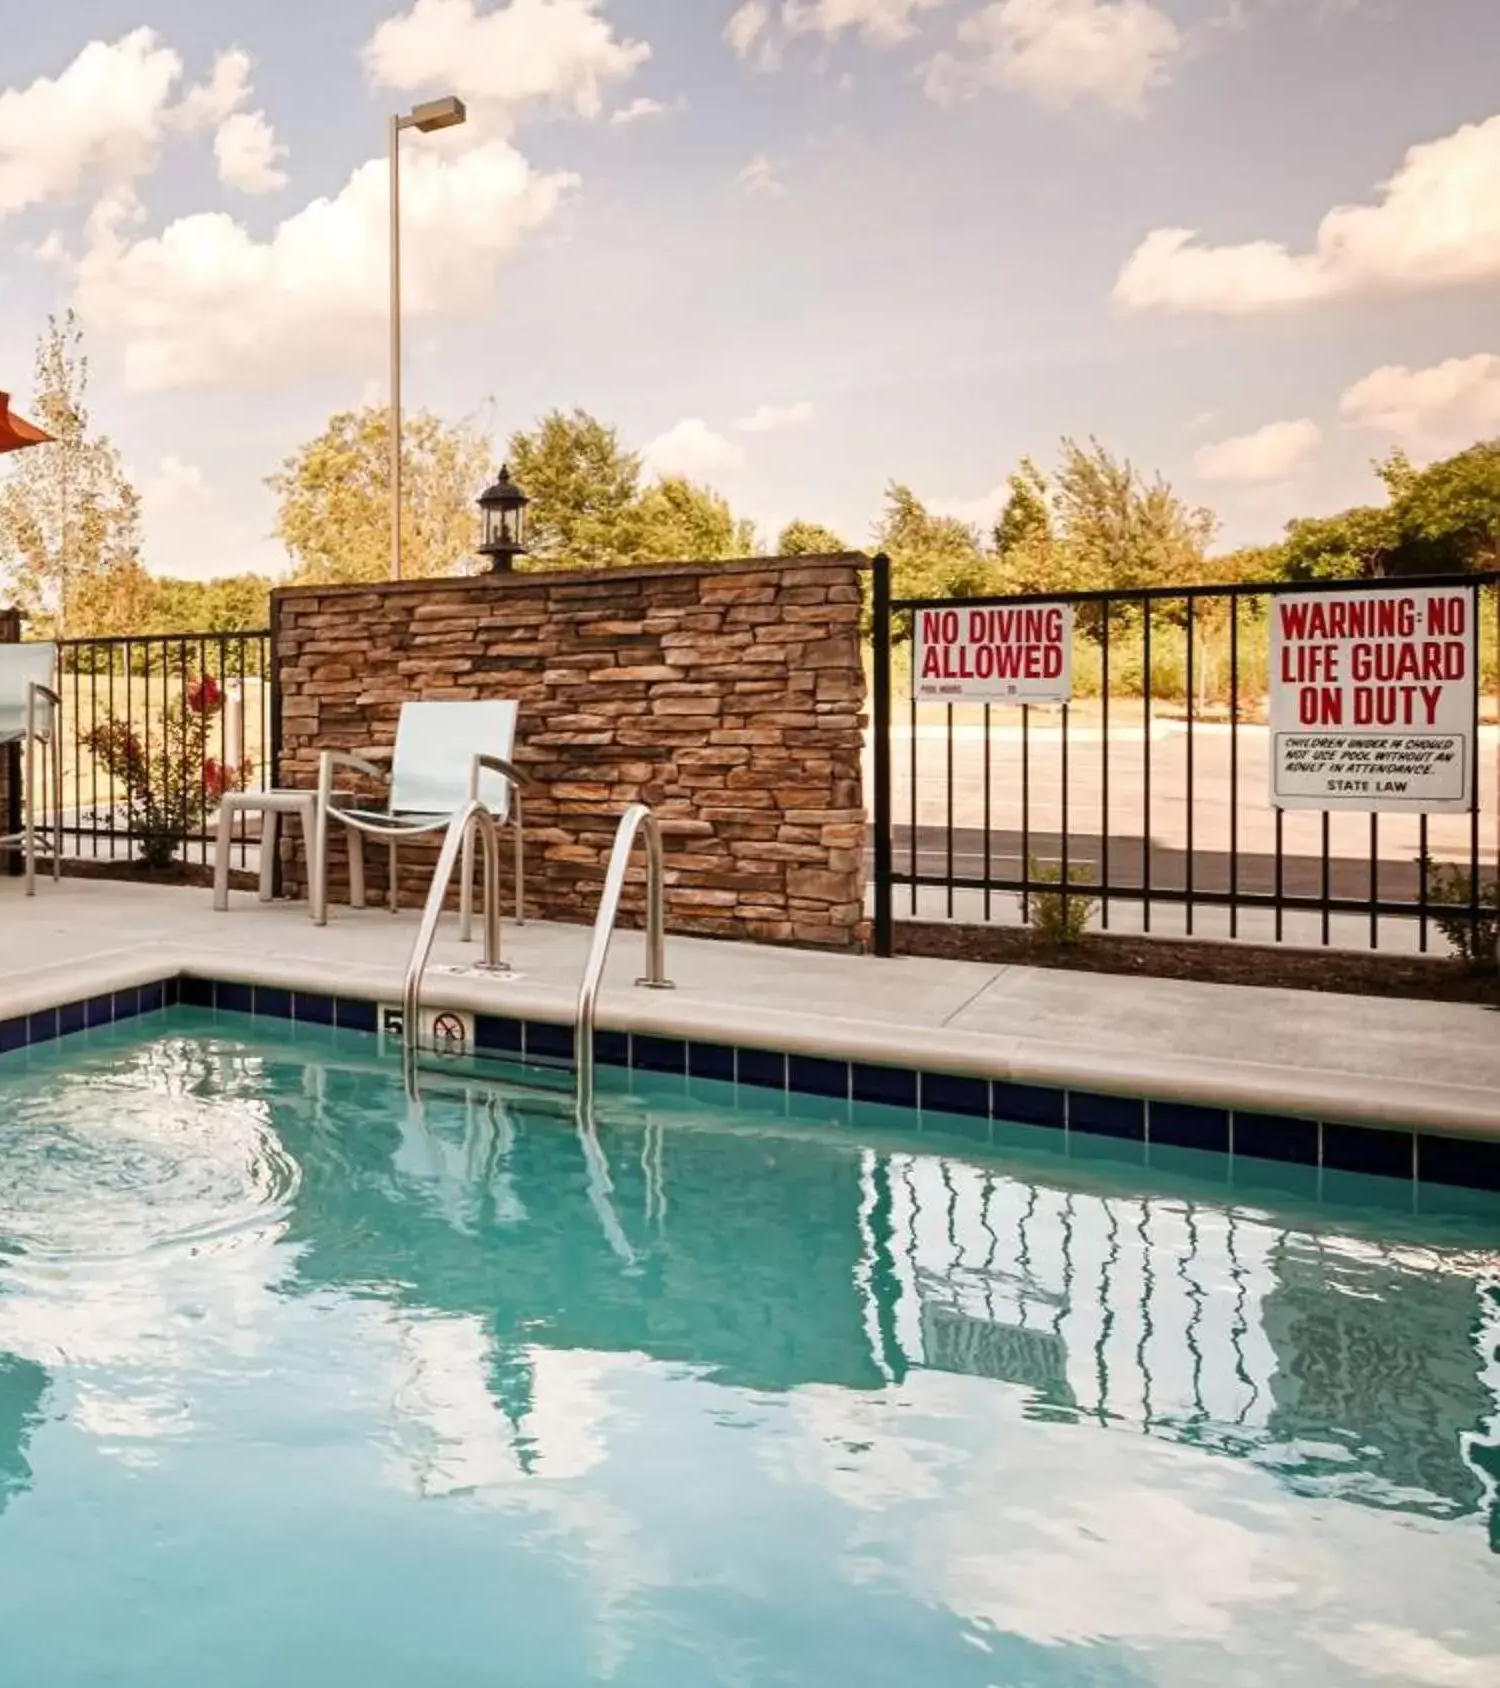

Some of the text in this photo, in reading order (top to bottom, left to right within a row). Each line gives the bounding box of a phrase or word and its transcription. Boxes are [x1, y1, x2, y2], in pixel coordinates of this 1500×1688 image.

[923, 608, 1063, 644] NO DIVING
[1427, 597, 1465, 636] NO
[921, 645, 1063, 679] ALLOWED
[1281, 642, 1465, 682] LIFE GUARD
[1300, 686, 1442, 724] ON DUTY
[1285, 738, 1345, 748] CHILDREN
[1348, 739, 1388, 749] UNDER
[1285, 750, 1454, 762] NOT USE POOL WITHOUT AN
[1285, 762, 1325, 772] ADULT
[1328, 763, 1344, 772] IN
[1327, 780, 1408, 792] STATE LAW
